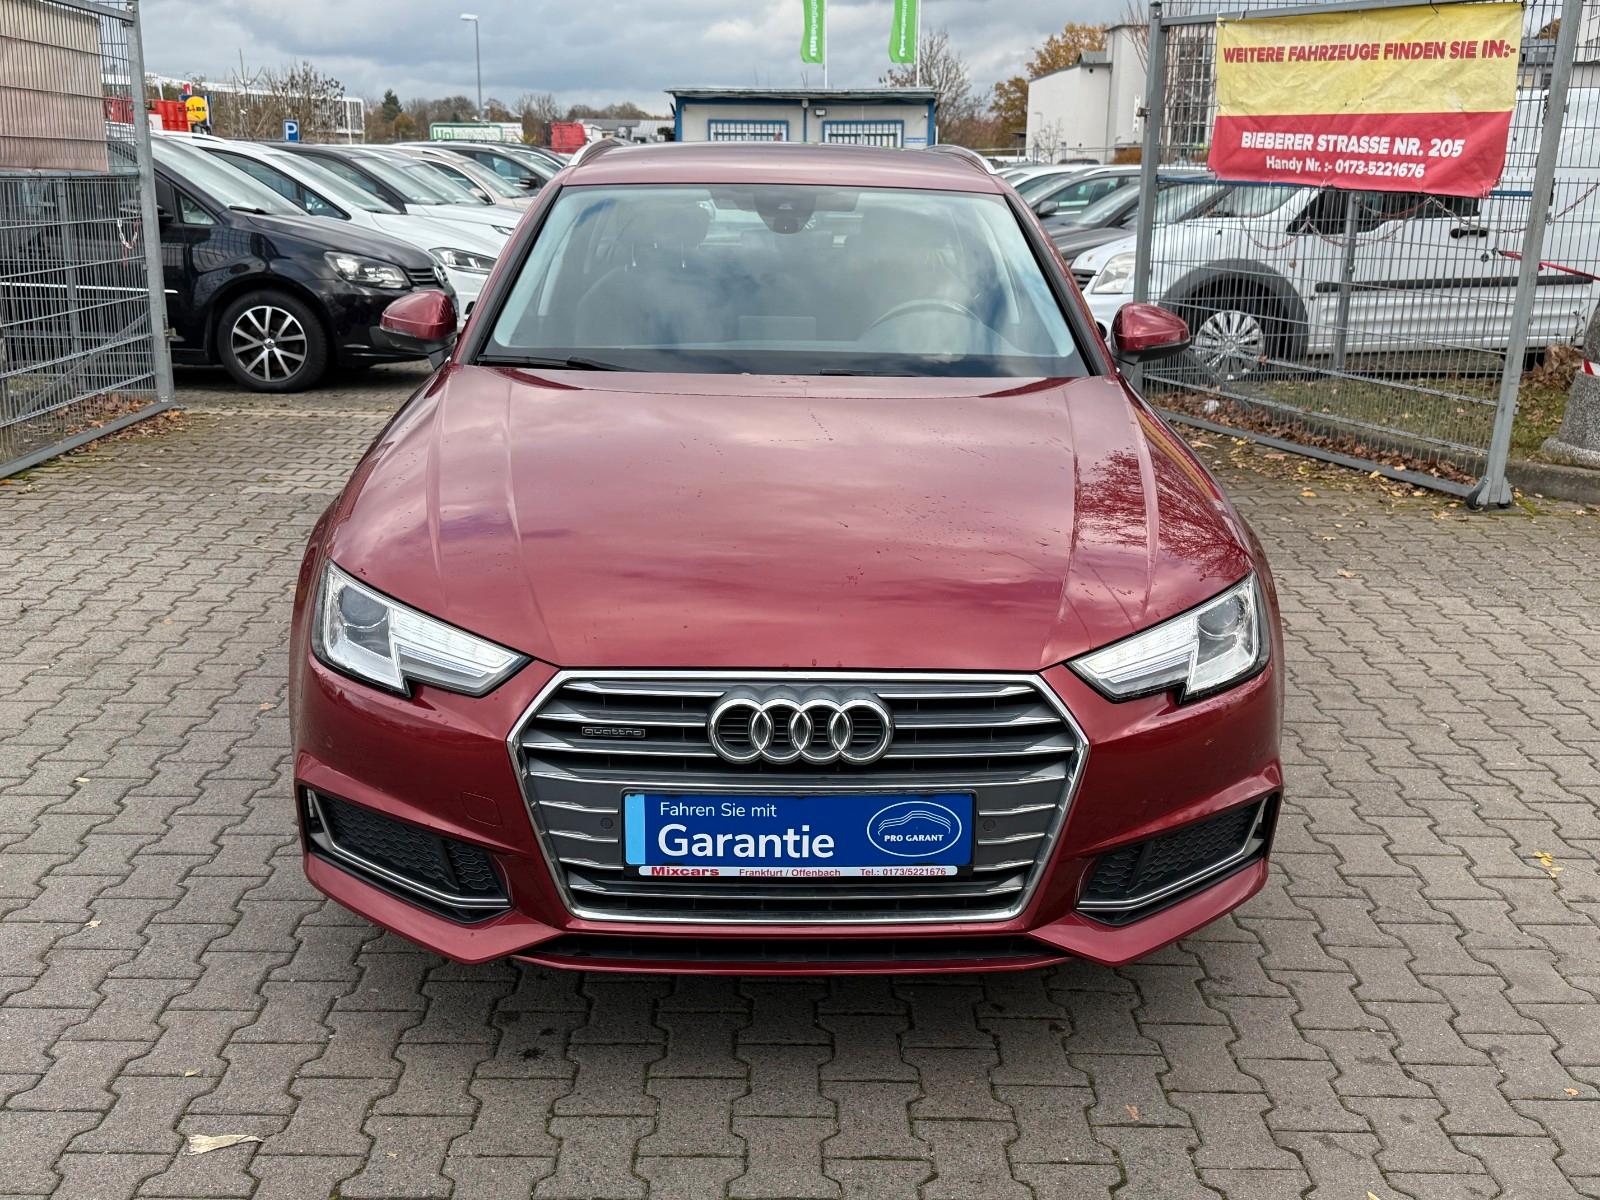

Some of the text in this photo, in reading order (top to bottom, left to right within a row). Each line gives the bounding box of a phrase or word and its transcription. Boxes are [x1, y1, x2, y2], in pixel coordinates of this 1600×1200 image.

[1223, 46, 1285, 63] WEITERE
[1288, 43, 1381, 62] FAHRZEUGE
[1384, 41, 1446, 61] FINDEN
[1450, 40, 1479, 59] SIE
[285, 122, 298, 141] P
[1241, 131, 1466, 158] BIEBERER STRASSE NR. 205
[1266, 156, 1303, 174] Handy
[1305, 157, 1322, 173] Nr.
[1335, 159, 1426, 179] 0173-5221676
[584, 728, 642, 736] quattro
[659, 802, 777, 818] Fahren Sie mit
[658, 823, 836, 858] Garantie
[884, 834, 944, 842] PRO GARANT
[651, 866, 720, 876] Mixcars
[739, 868, 783, 877] Frankfurt
[791, 868, 841, 877] Offenbach
[860, 868, 880, 877] Tel.:
[882, 868, 947, 877] 0173/5221676
